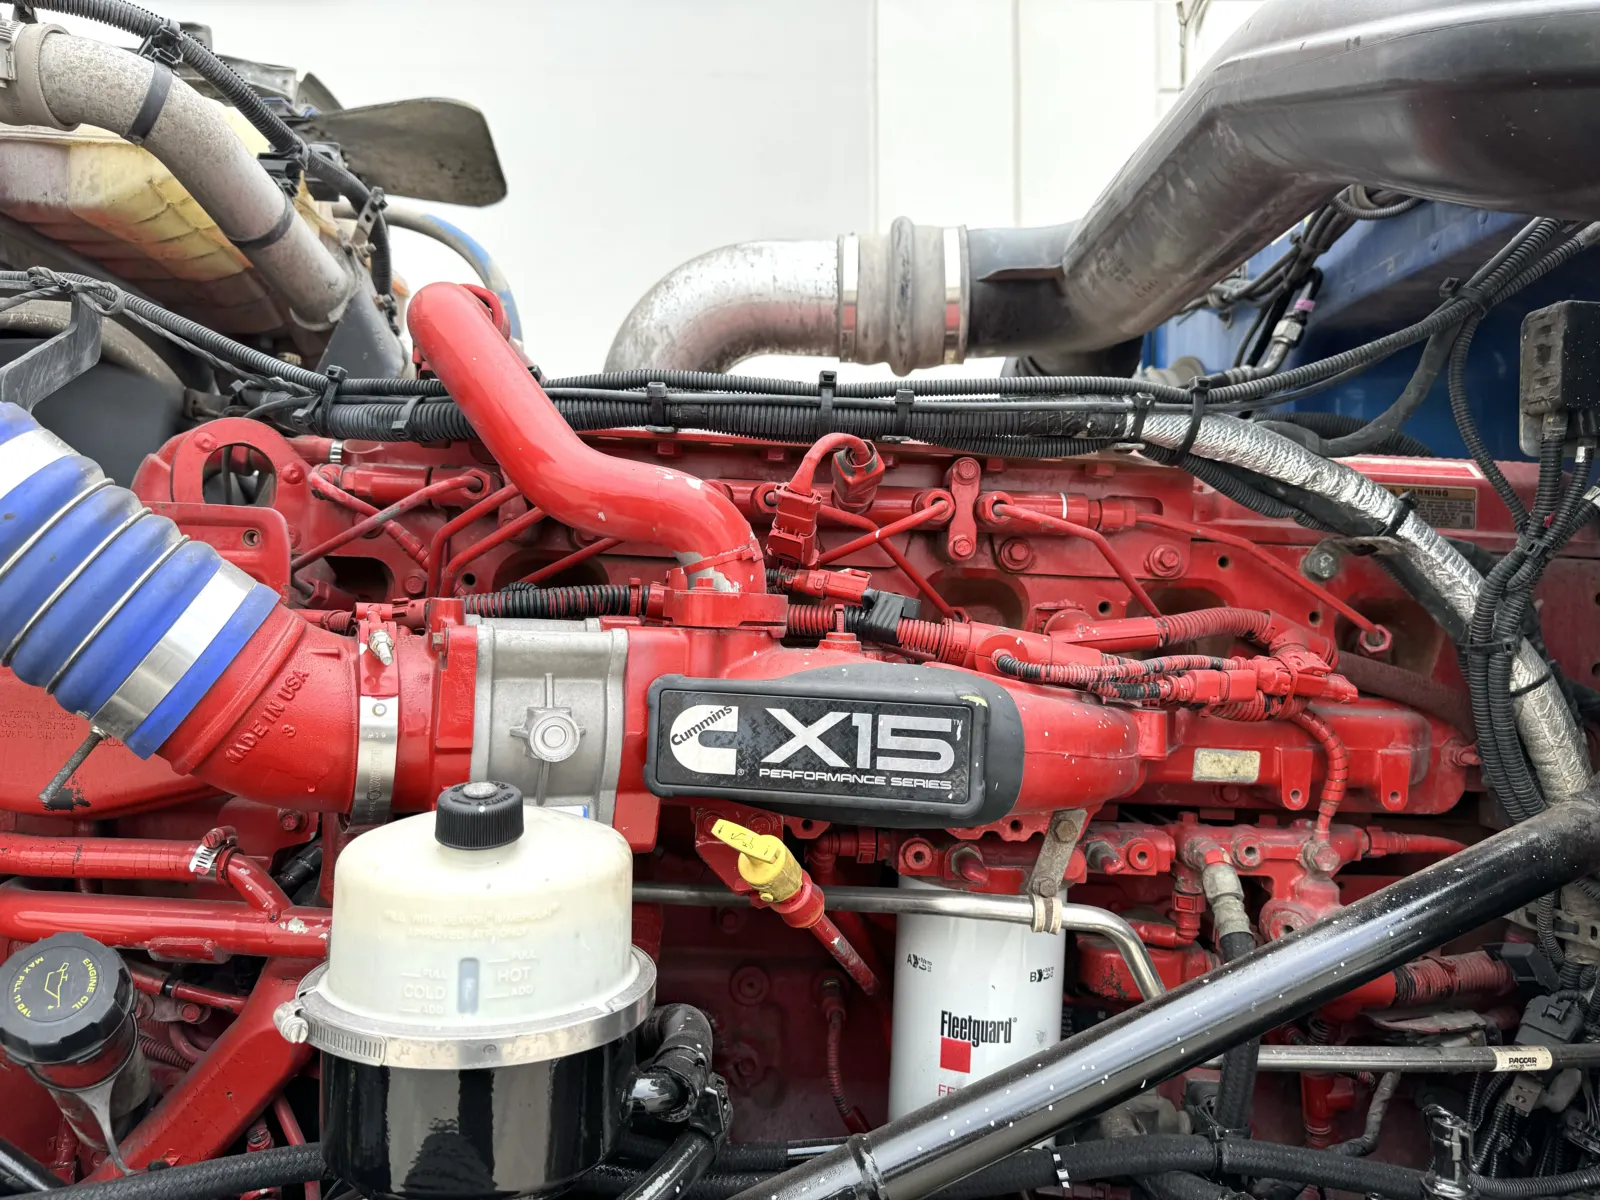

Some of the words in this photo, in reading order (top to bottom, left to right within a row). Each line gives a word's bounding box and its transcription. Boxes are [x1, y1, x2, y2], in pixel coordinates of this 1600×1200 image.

[225, 719, 269, 764] MADE
[262, 700, 285, 724] IN
[278, 670, 309, 702] USA
[671, 705, 733, 746] Cummins
[760, 707, 956, 774] X15
[759, 768, 886, 786] PERFORMANCE
[890, 776, 952, 790] SERIES
[23, 956, 45, 974] MAX
[82, 957, 98, 994] ENGINE
[497, 966, 532, 983] HOT
[1029, 971, 1037, 983] B
[13, 975, 25, 993] FILL
[404, 984, 447, 1000] COLD
[13, 994, 22, 1004] 11
[71, 995, 89, 1010] OIL
[17, 1003, 33, 1018] GAL
[940, 1009, 1012, 1048] Fleetguard
